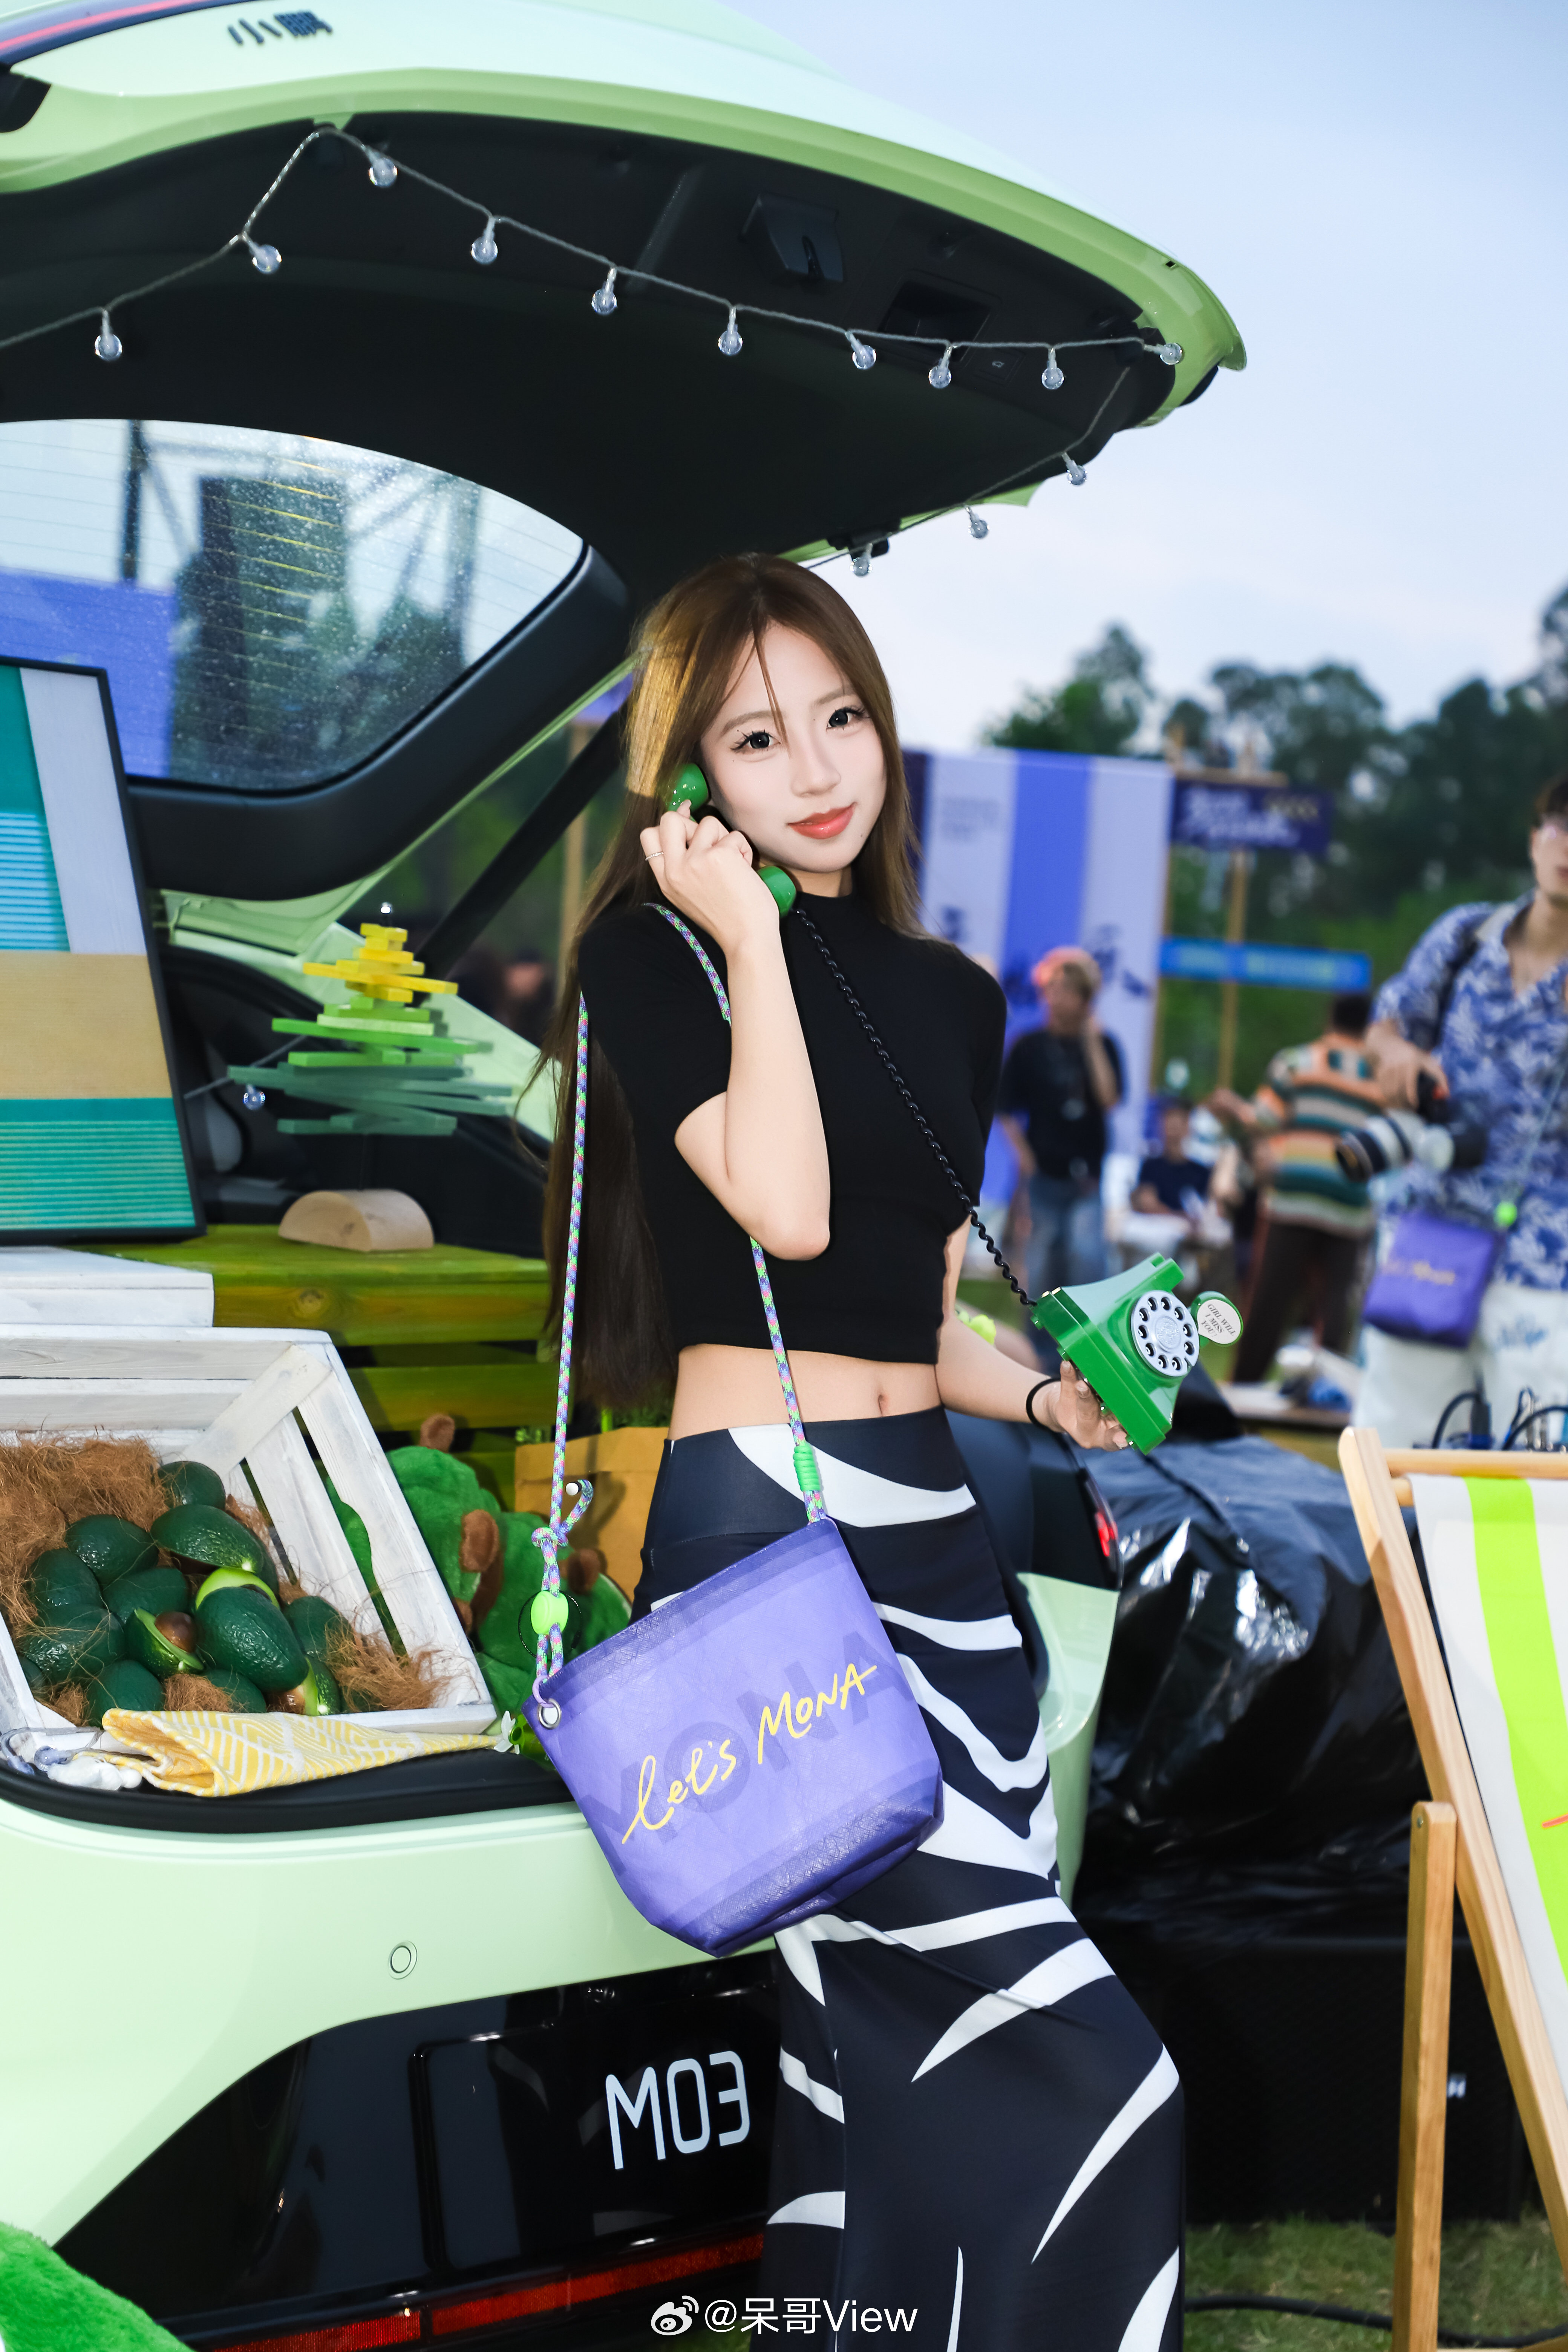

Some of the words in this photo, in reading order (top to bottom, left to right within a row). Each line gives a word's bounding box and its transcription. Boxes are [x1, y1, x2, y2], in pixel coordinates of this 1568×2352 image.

[1208, 1304, 1222, 1319] GIRL
[1221, 1318, 1236, 1336] WILL
[1209, 1318, 1224, 1333] MISS
[605, 2050, 750, 2170] M03
